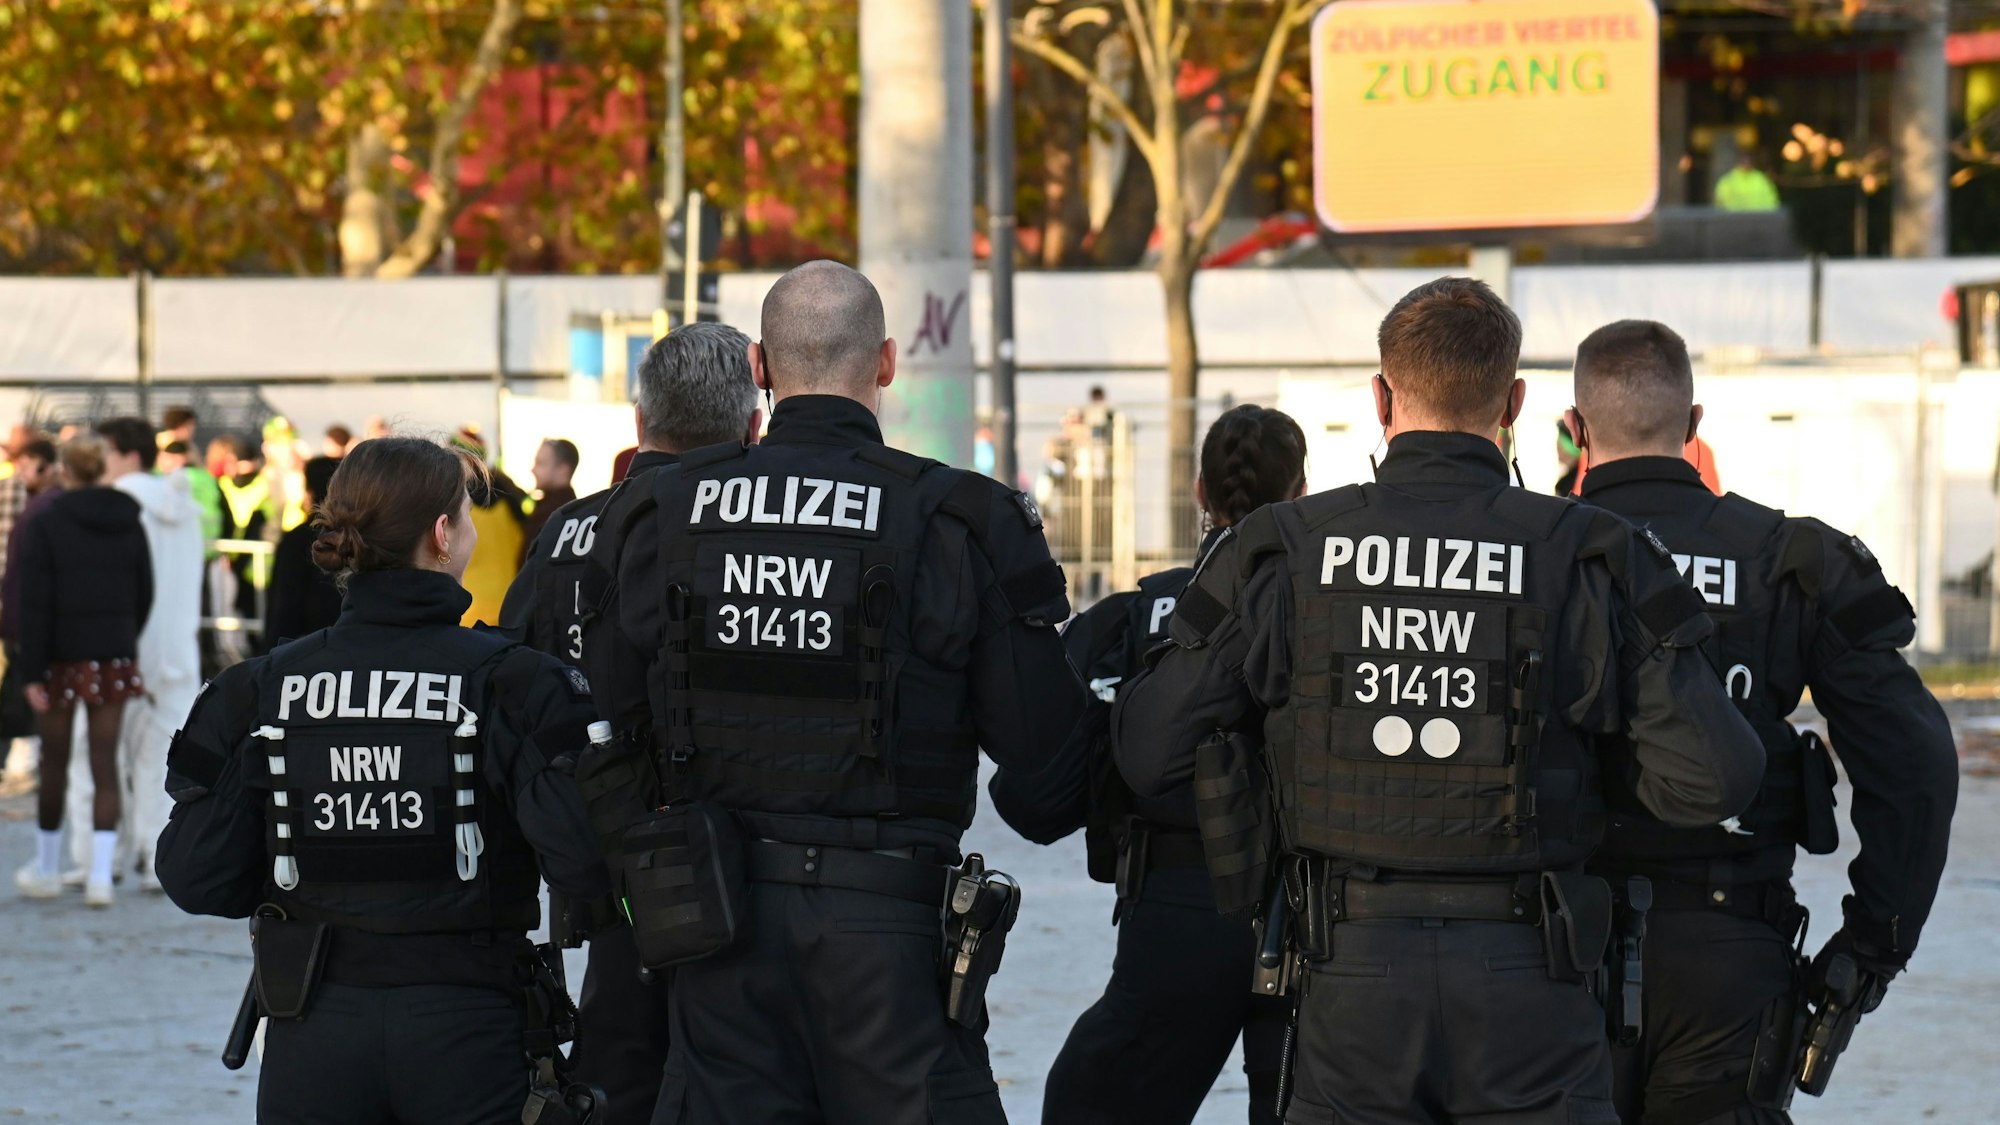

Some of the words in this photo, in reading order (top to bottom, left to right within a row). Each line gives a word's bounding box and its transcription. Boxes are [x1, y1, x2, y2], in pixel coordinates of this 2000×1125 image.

[1329, 20, 1505, 53] ZÜLPICHER
[1513, 14, 1642, 44] VIERTEL
[1362, 53, 1607, 101] ZUGANG
[690, 475, 882, 532] POLIZEI
[723, 553, 833, 599] NRW
[1320, 534, 1524, 595] POLIZEI
[717, 603, 832, 651] 31413
[1361, 605, 1476, 654] NRW
[278, 670, 463, 723] POLIZEI
[1355, 662, 1476, 709] 31413
[329, 745, 402, 782] NRW
[313, 790, 424, 831] 31413
